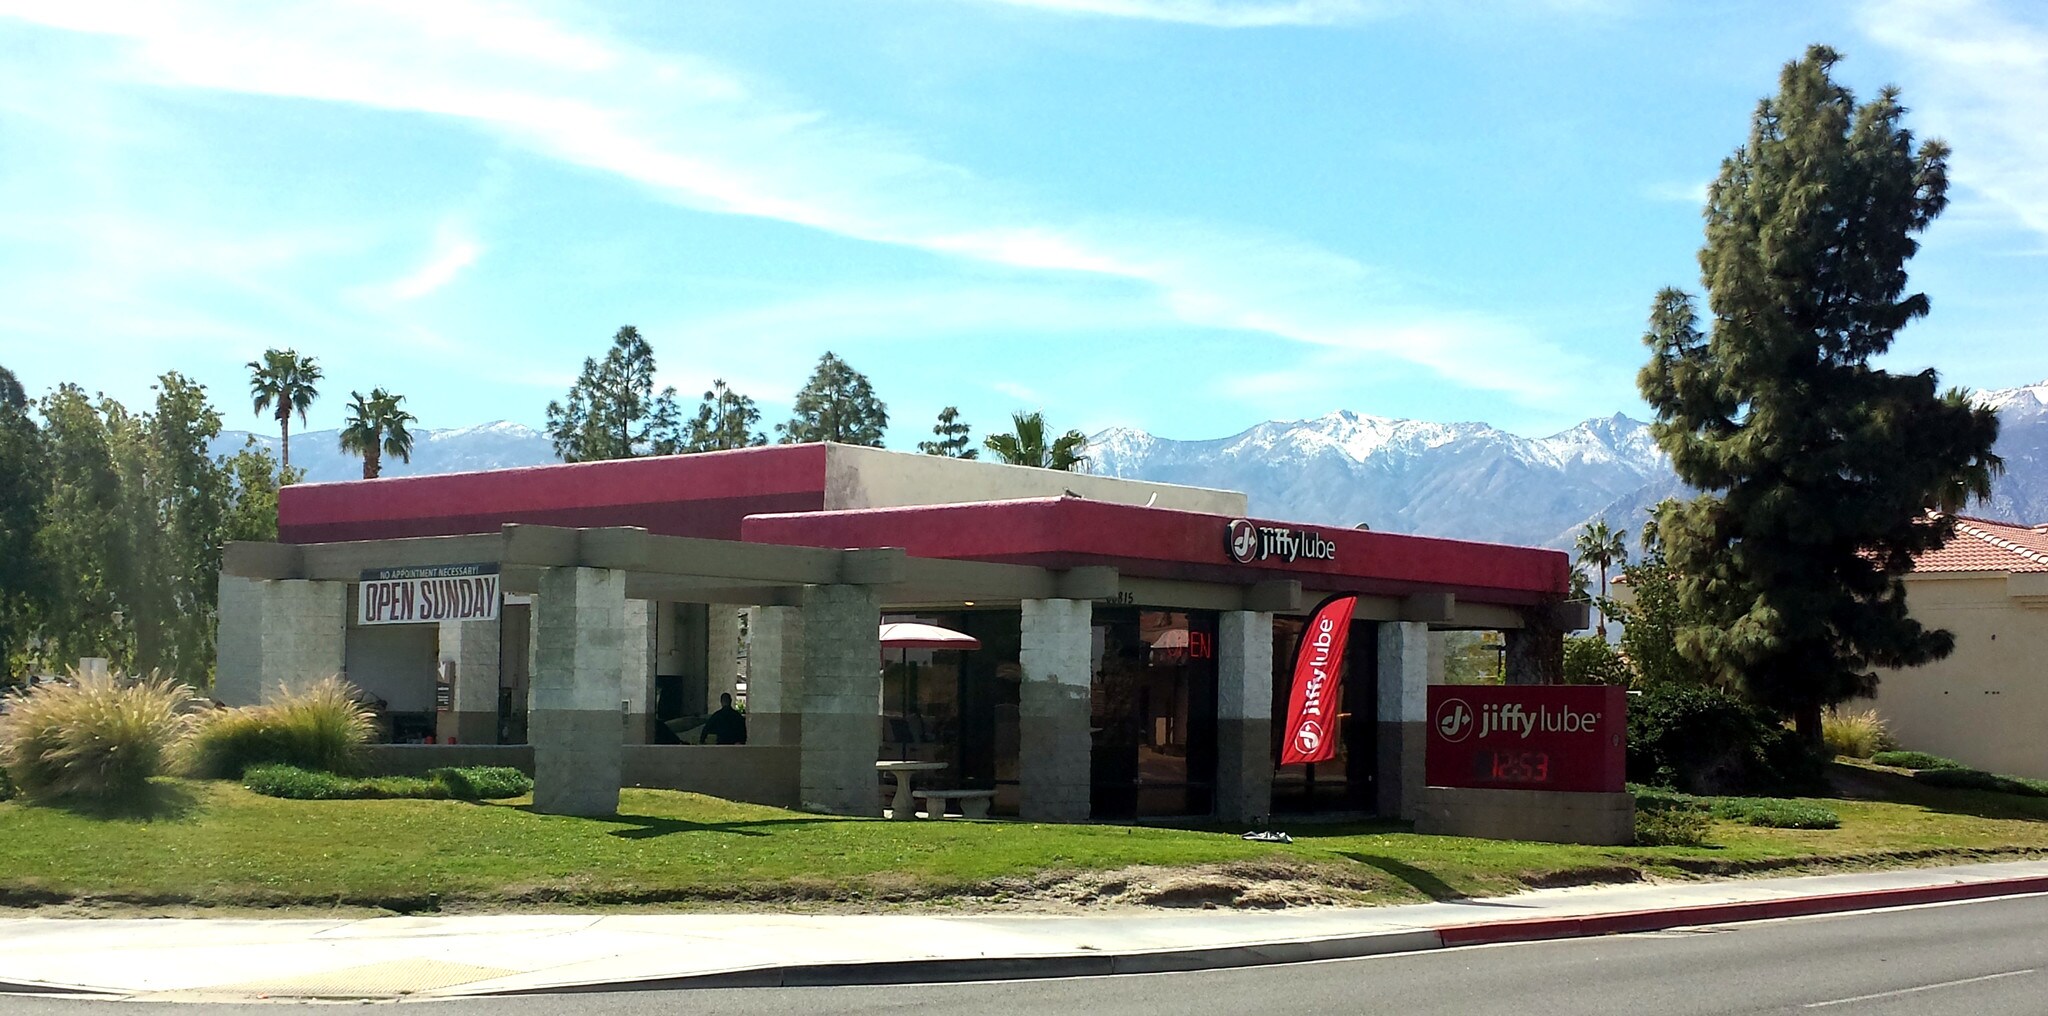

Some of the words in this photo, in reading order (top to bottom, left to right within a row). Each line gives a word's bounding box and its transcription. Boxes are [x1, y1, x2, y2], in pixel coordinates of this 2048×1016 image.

[380, 571, 390, 580] NO
[391, 568, 437, 579] APPOINTMENT
[438, 566, 479, 577] NECESSARY!
[365, 581, 415, 622] OPEN
[420, 577, 496, 620] SUNDAY
